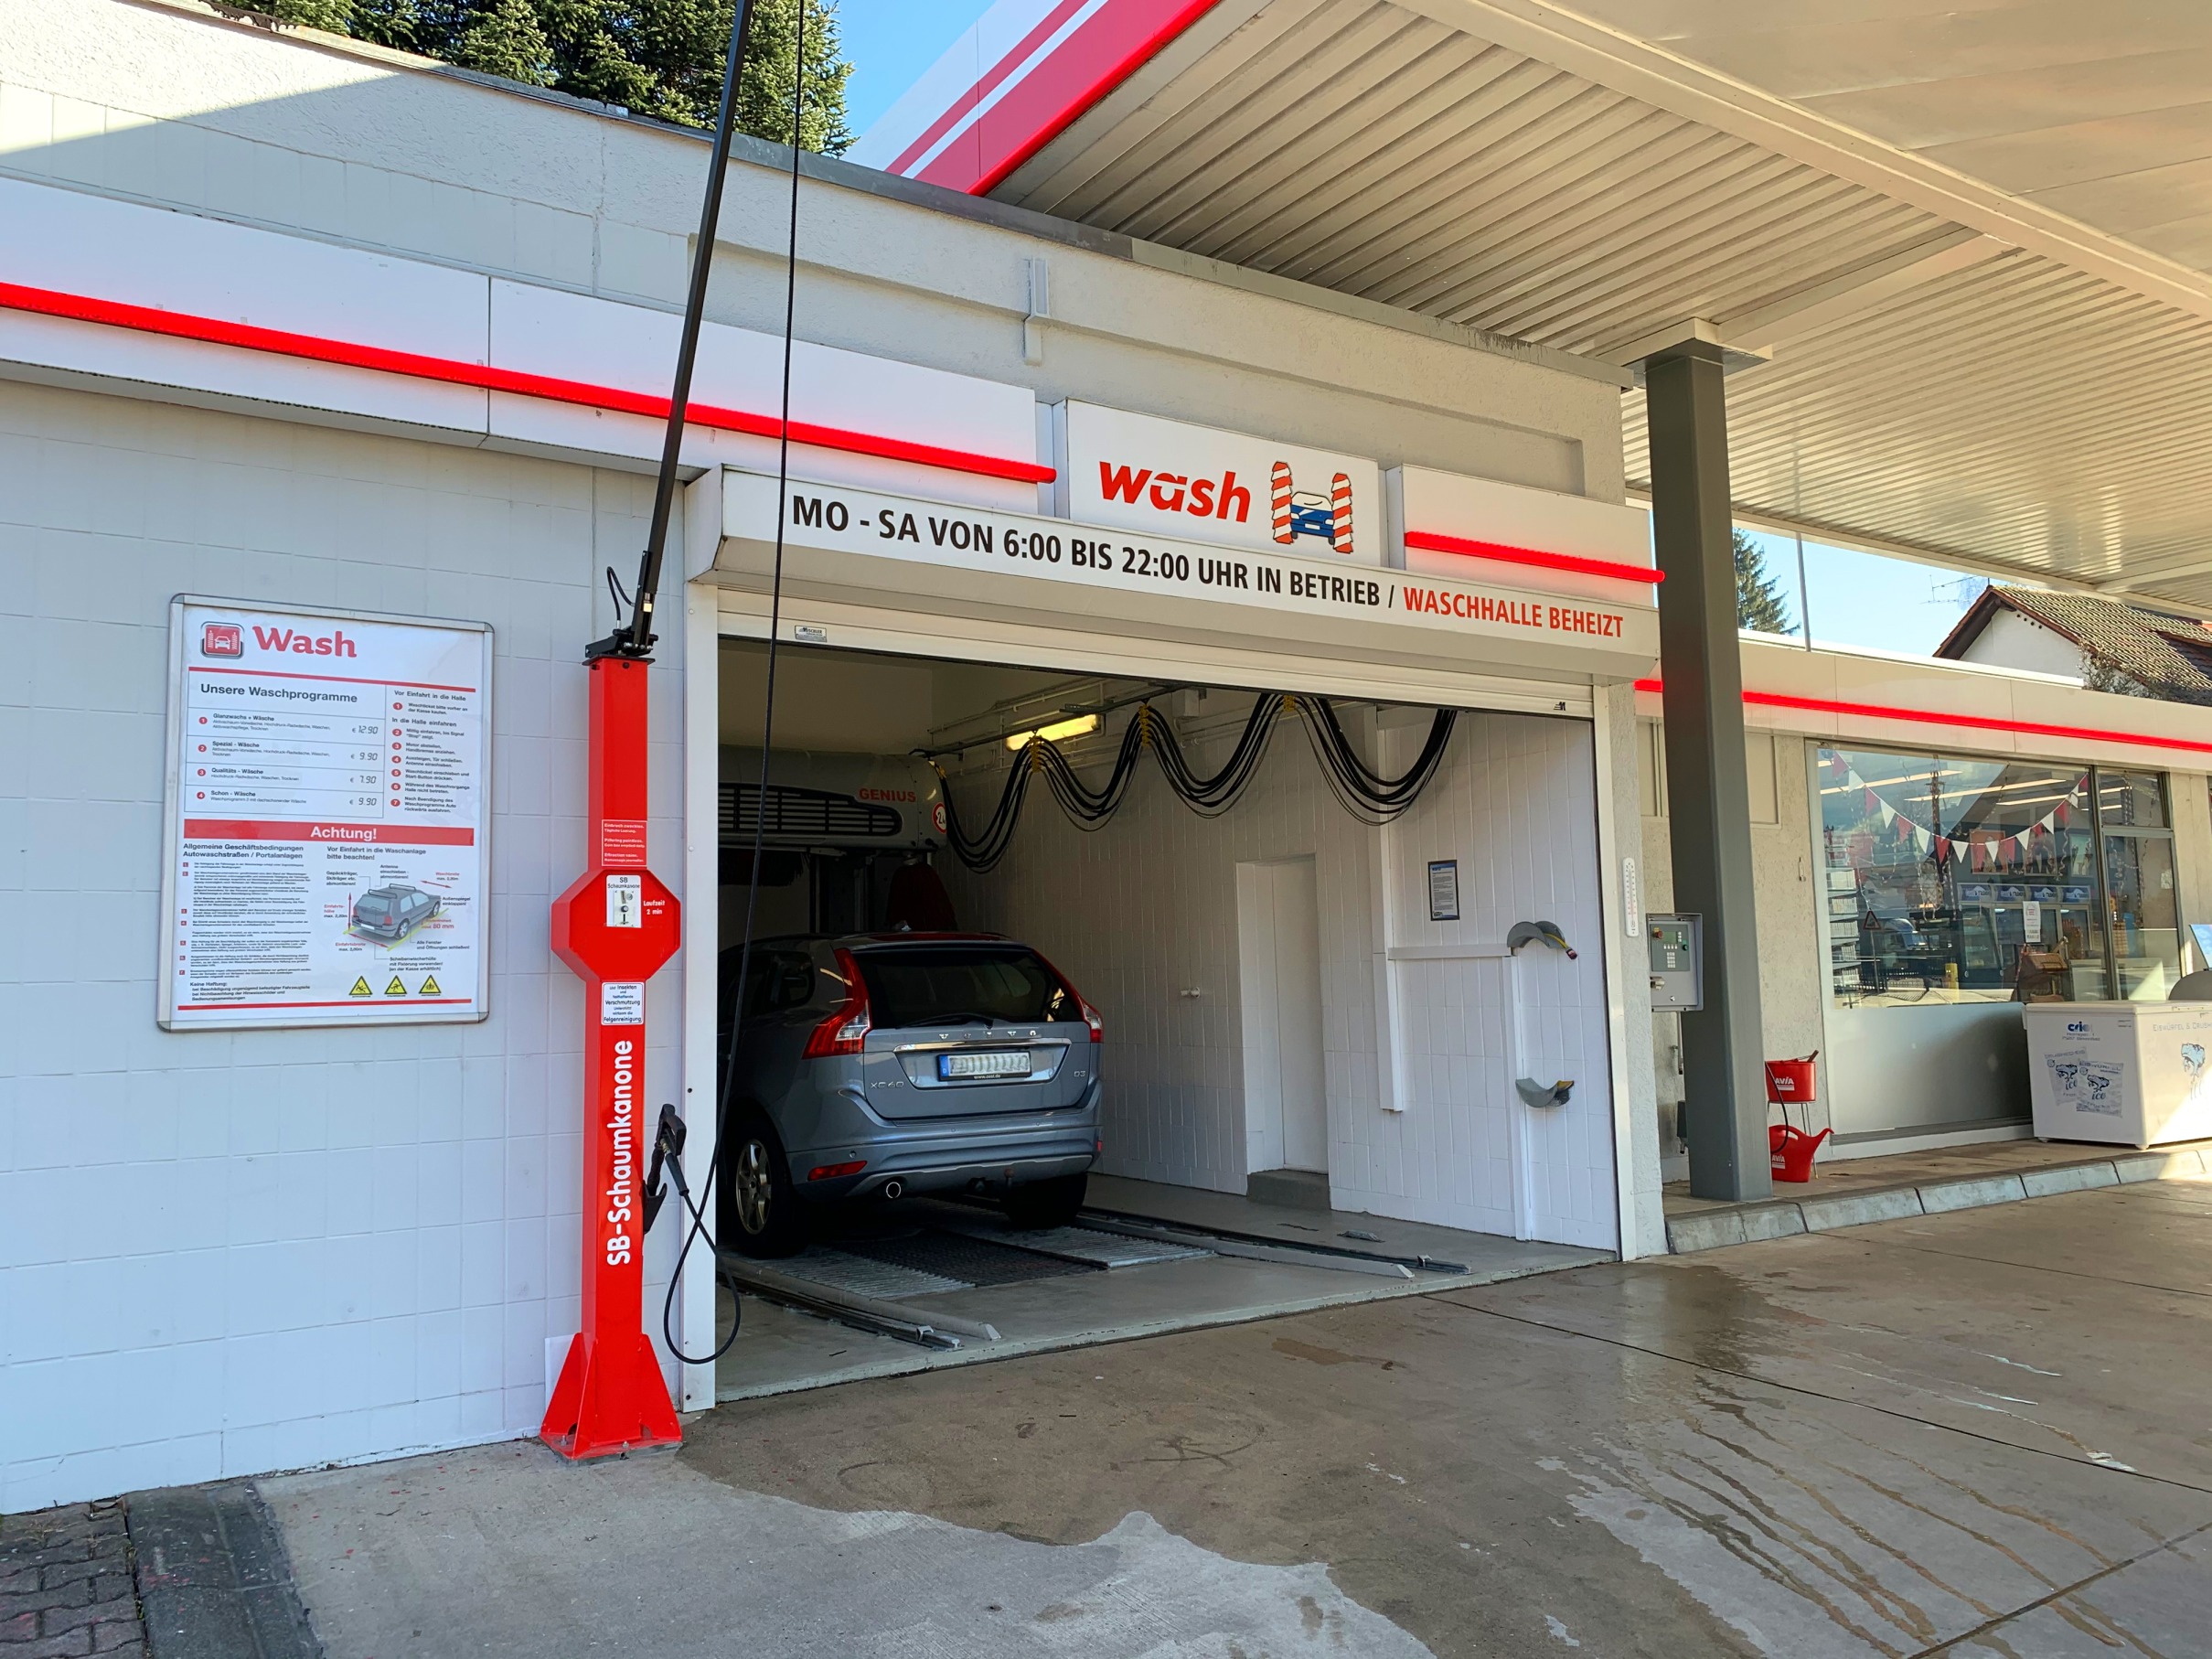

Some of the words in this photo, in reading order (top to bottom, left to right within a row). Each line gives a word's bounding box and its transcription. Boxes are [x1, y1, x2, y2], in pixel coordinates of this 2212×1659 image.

[1099, 461, 1251, 523] wash
[794, 495, 849, 531] MO
[879, 509, 921, 543] SA
[928, 516, 993, 553] VON
[1004, 529, 1062, 562] 6:00
[1072, 540, 1113, 570] BIS
[1122, 547, 1190, 581] 22:00
[1198, 558, 1248, 589] UHR
[1257, 566, 1281, 594] IN
[1290, 571, 1380, 605] BETRIEB
[1388, 584, 1395, 608] /
[1404, 586, 1543, 627] WASCHHALLE
[1549, 607, 1623, 638] BEHEIZT
[252, 626, 357, 658] Wash
[201, 684, 245, 695] Unsere
[249, 687, 358, 702] Waschprogramme
[358, 725, 379, 734] 12.90
[359, 753, 379, 761] 9.90
[358, 797, 377, 806] 9.90
[860, 788, 916, 803] GENIUS
[311, 827, 377, 841] Achtung!
[871, 1081, 904, 1089] XC60
[606, 1040, 633, 1266] SB-Schaumkanone
